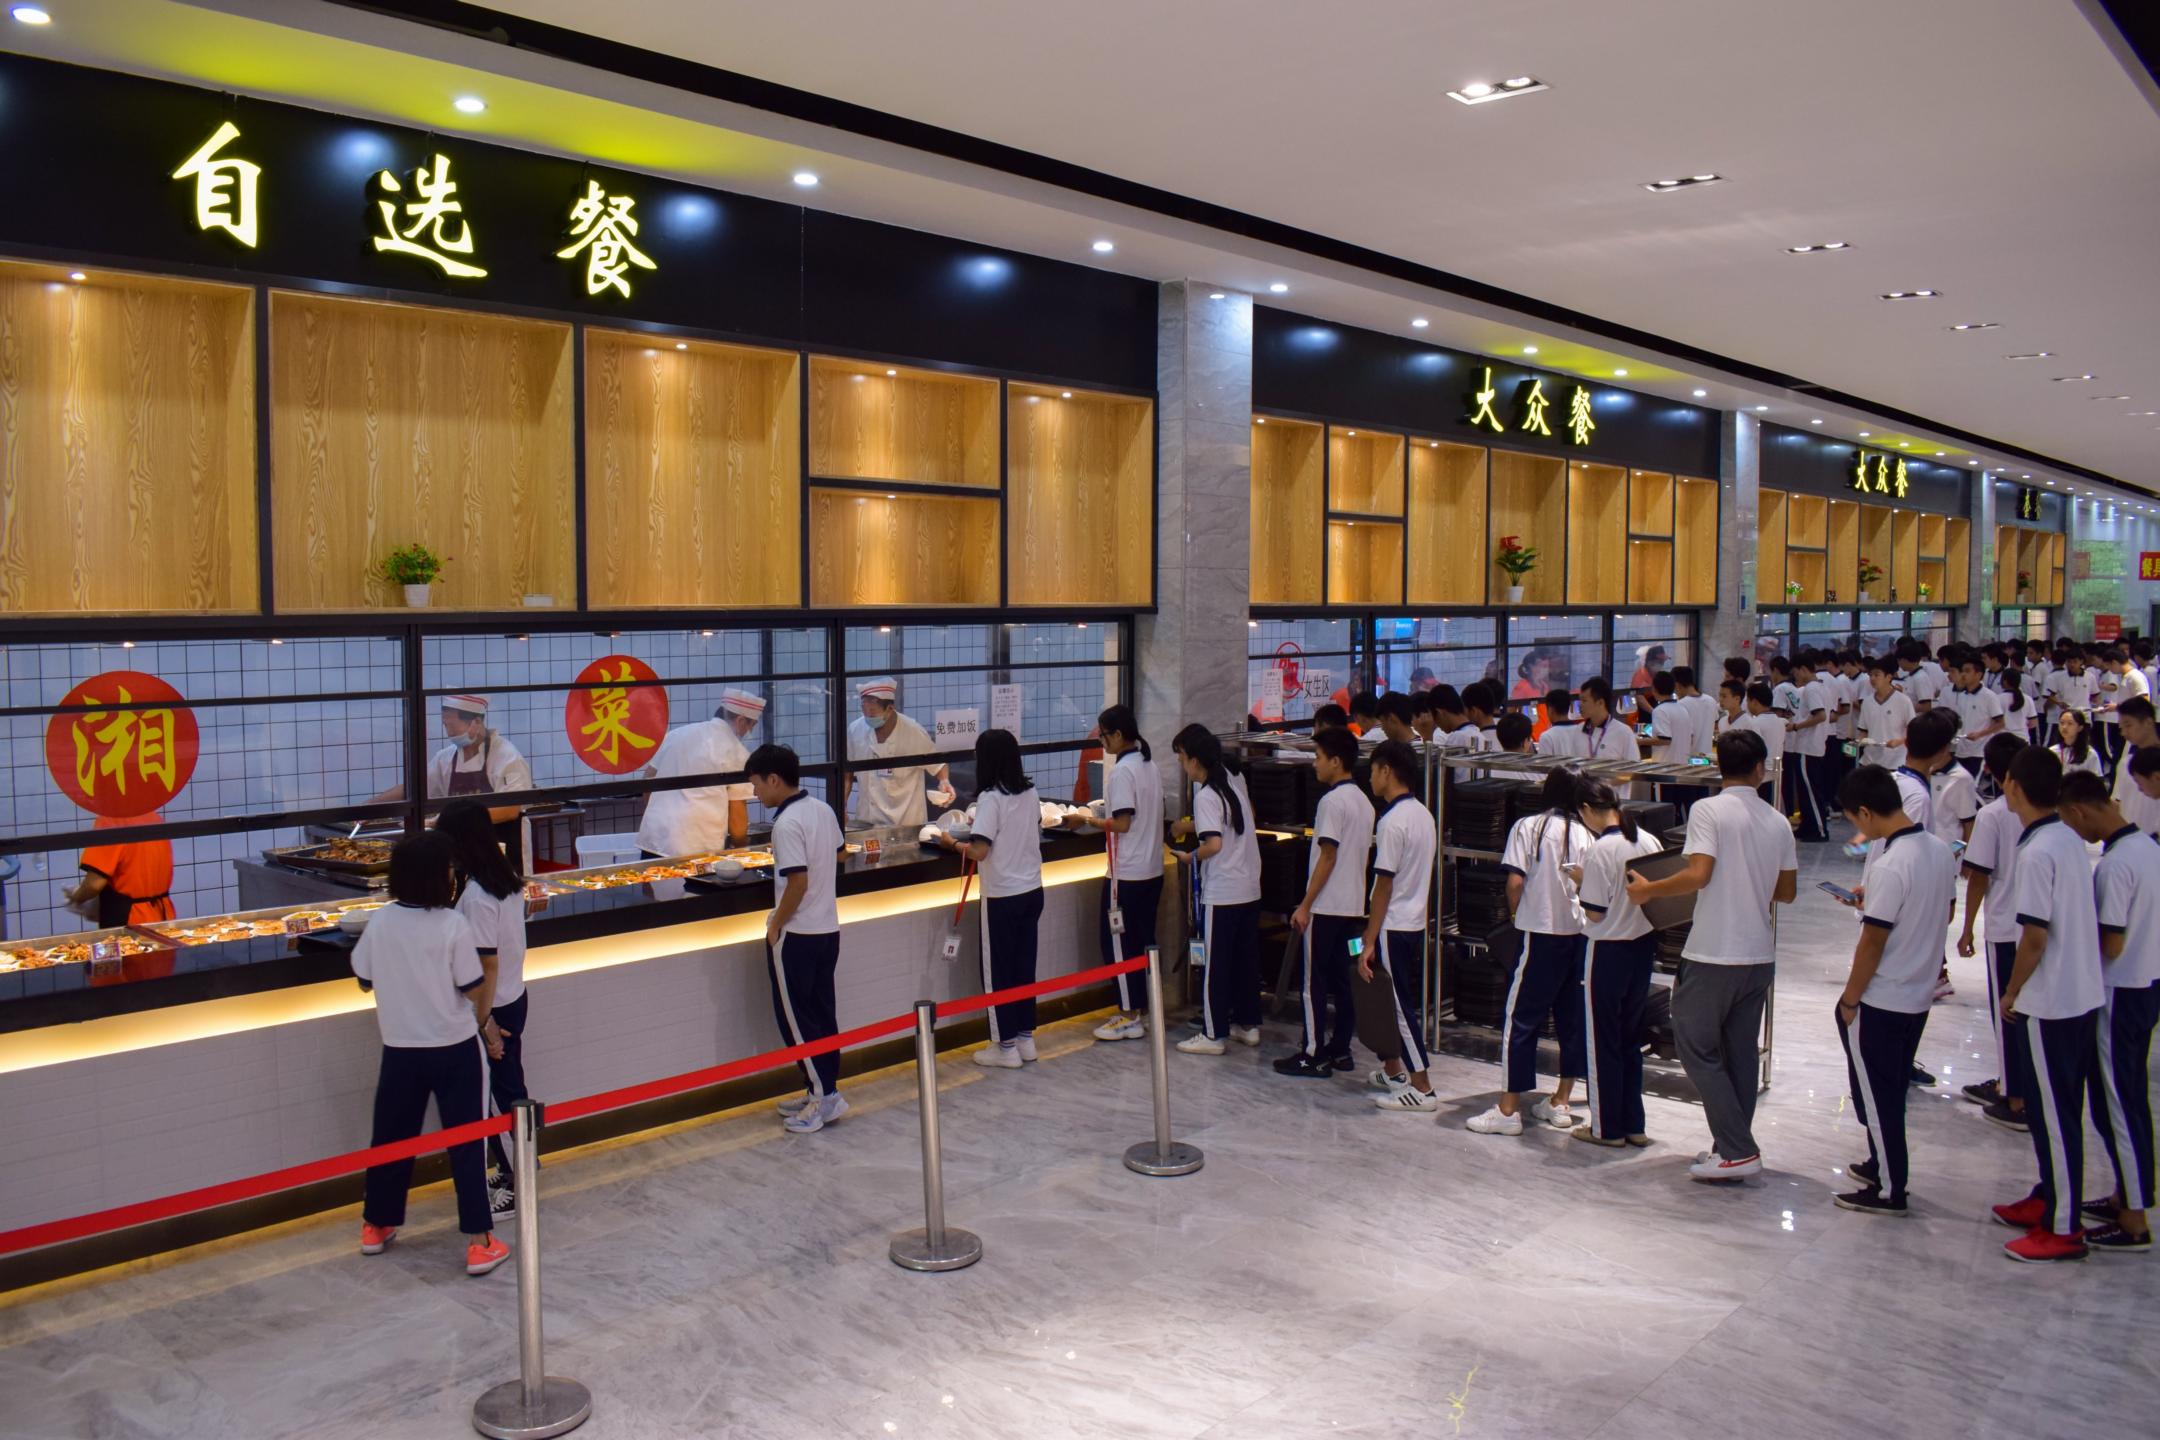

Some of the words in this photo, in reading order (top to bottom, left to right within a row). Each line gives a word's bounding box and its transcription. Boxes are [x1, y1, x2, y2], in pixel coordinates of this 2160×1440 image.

[172, 120, 659, 299] 自选餐
[1470, 366, 1596, 446] 大众餐
[1854, 450, 1909, 498] 大众餐
[1303, 673, 1330, 699] 女生区
[936, 719, 977, 735] 免费加饭
